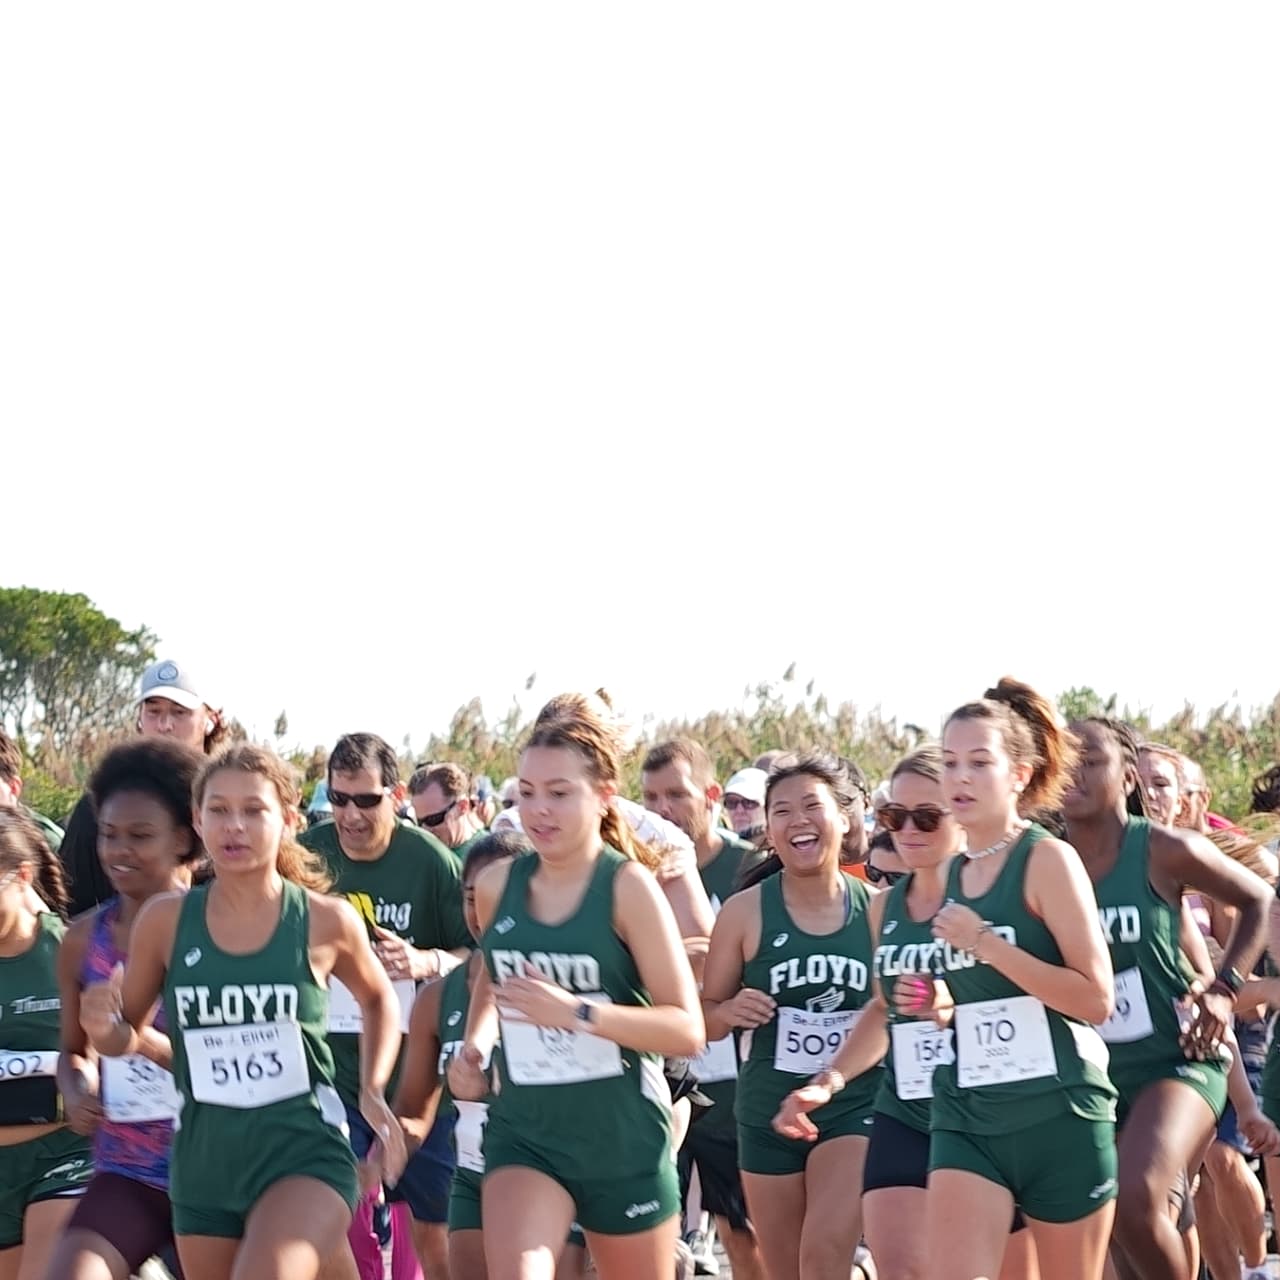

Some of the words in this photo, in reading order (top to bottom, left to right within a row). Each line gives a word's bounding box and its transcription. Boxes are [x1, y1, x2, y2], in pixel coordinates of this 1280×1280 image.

[769, 955, 867, 995] FLOYD
[873, 943, 938, 979] FLOY
[174, 983, 298, 1028] FLOYD
[975, 1019, 1015, 1046] 170
[211, 1051, 283, 1085] 5163
